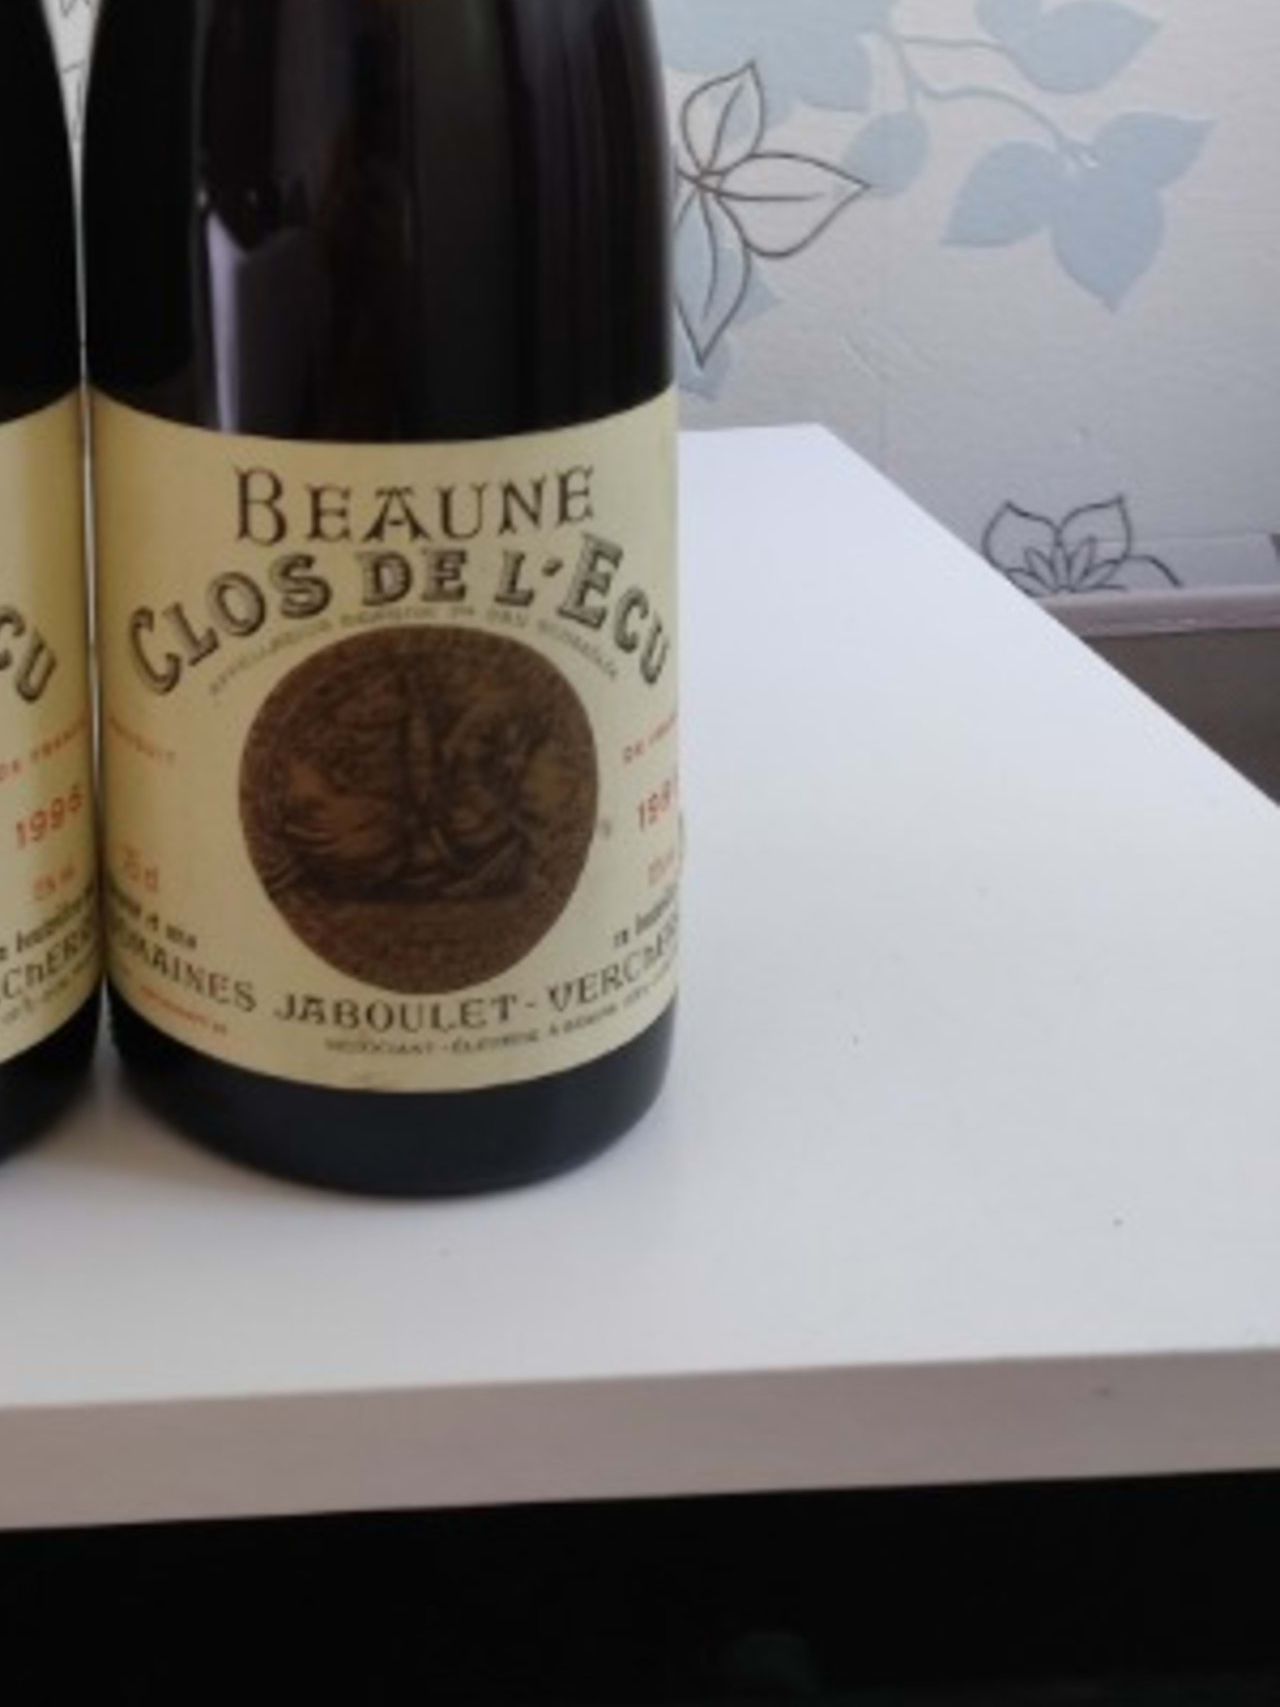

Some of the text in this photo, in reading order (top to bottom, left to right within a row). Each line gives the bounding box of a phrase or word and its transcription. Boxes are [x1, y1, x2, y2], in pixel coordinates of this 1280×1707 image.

[235, 463, 595, 546] BEAUNE
[127, 552, 332, 696] CLOS
[356, 547, 470, 608] DE
